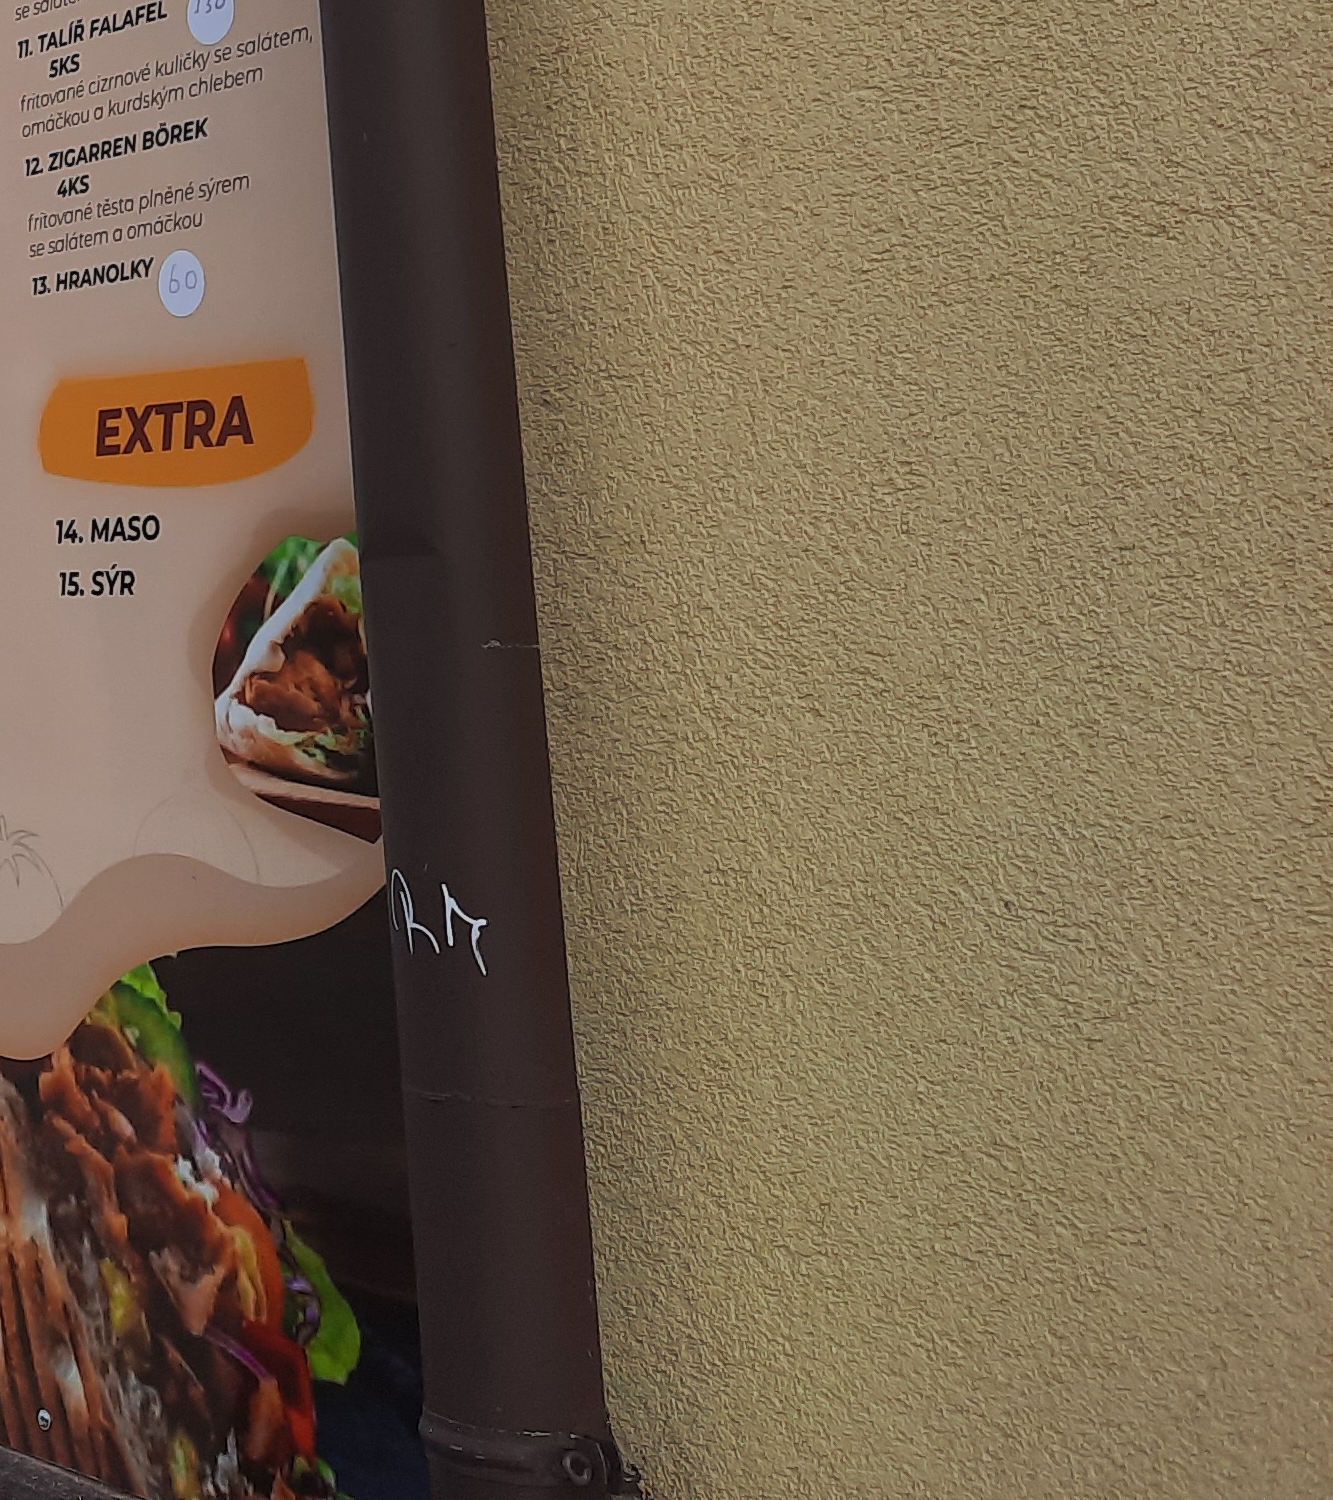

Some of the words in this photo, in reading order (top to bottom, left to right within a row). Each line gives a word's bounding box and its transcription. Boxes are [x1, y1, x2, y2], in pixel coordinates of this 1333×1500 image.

[14, 4, 29, 21] se
[17, 39, 33, 58] 11.
[37, 18, 85, 54] TALÍŘ
[90, 0, 168, 40] FALAFEL
[21, 80, 85, 113] fritované
[88, 64, 151, 96] cizrnové
[155, 51, 209, 80] kuličky
[213, 45, 232, 64] se
[236, 26, 313, 59] salátem,
[49, 54, 80, 79] 5KS
[22, 108, 90, 138] omáčkou
[94, 106, 103, 122] a
[108, 86, 184, 118] kurdským
[188, 67, 263, 98] chlebem
[25, 159, 43, 176] 12.
[48, 134, 136, 171] ZIGARREN
[142, 118, 209, 150] BÖREK
[28, 204, 92, 232] fritované
[97, 198, 134, 220] těsta
[139, 182, 193, 214] plněné
[198, 175, 251, 202] sýrem
[57, 175, 90, 198] 4KS
[29, 242, 44, 258] se
[48, 227, 108, 253] salátem
[127, 212, 204, 240] omáčkou
[32, 276, 51, 295] 13.
[56, 258, 154, 292] HRANOLKY
[169, 264, 197, 294] 60
[95, 396, 254, 457] EXTRA
[56, 519, 83, 544] 14.
[91, 515, 160, 543] MASO
[60, 571, 84, 596] 15.
[91, 564, 135, 596] SÝR
